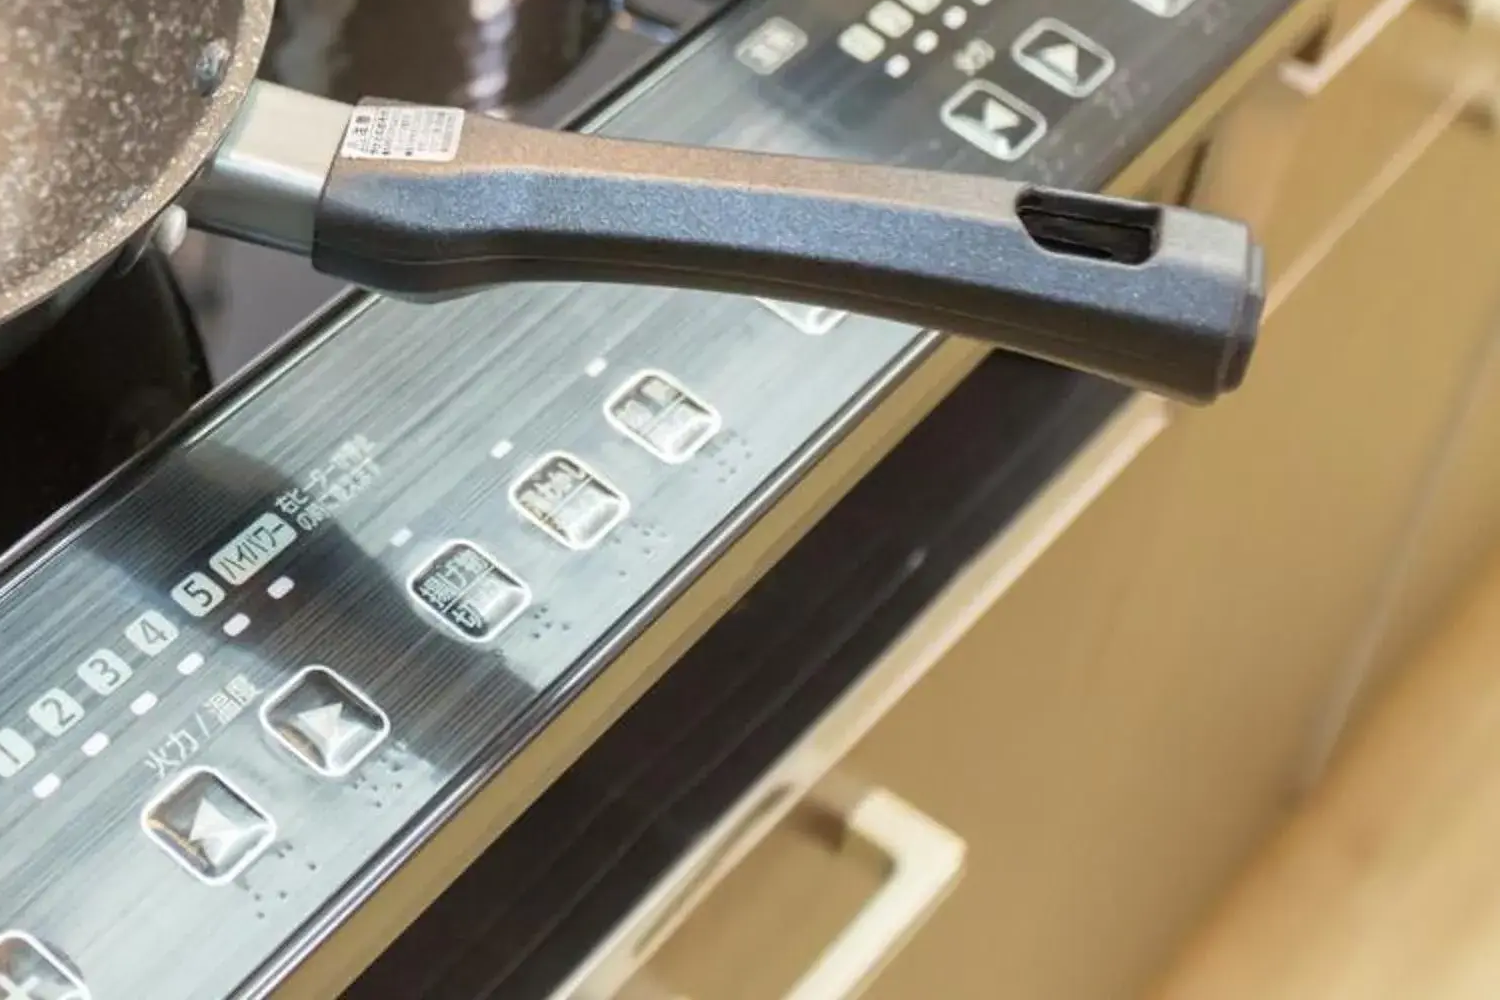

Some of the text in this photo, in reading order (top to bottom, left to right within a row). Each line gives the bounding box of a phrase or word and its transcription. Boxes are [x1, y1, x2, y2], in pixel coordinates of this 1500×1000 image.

[218, 523, 285, 581] ハイパワー
